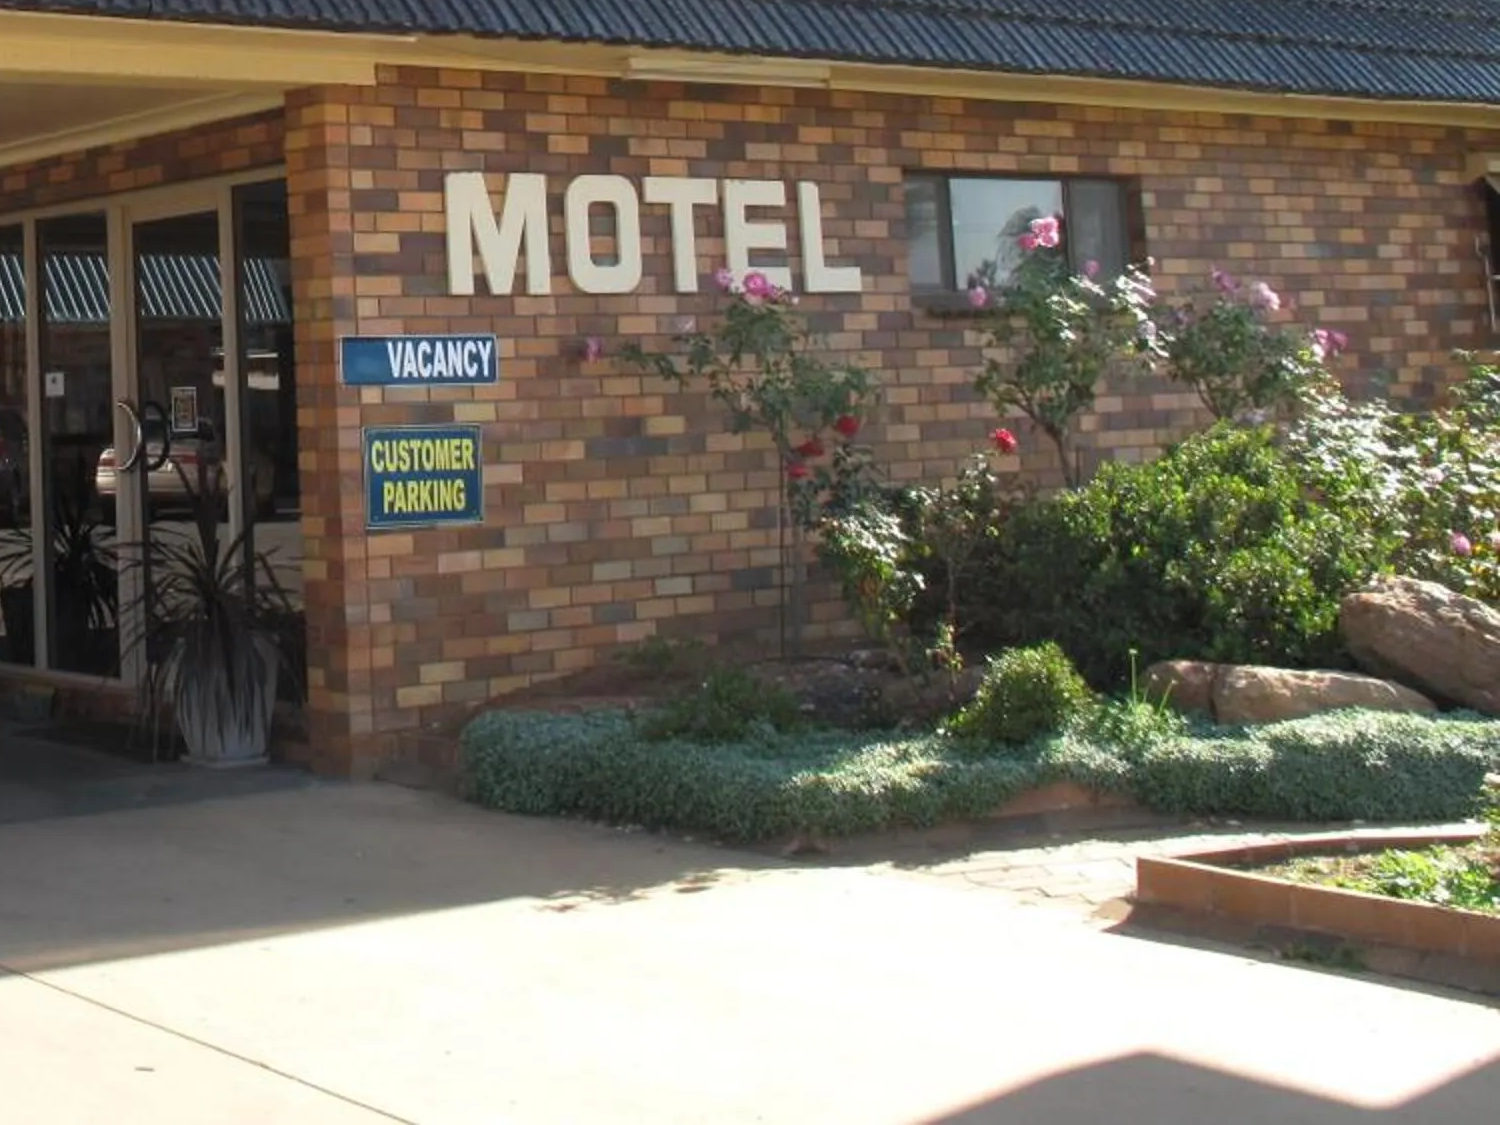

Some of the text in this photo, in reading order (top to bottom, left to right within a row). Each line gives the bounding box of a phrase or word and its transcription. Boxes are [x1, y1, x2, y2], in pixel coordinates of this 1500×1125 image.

[444, 172, 861, 296] MOTEL
[386, 340, 493, 378] VACANCY
[371, 438, 476, 473] CUSTOMER
[383, 478, 466, 514] PARKING
